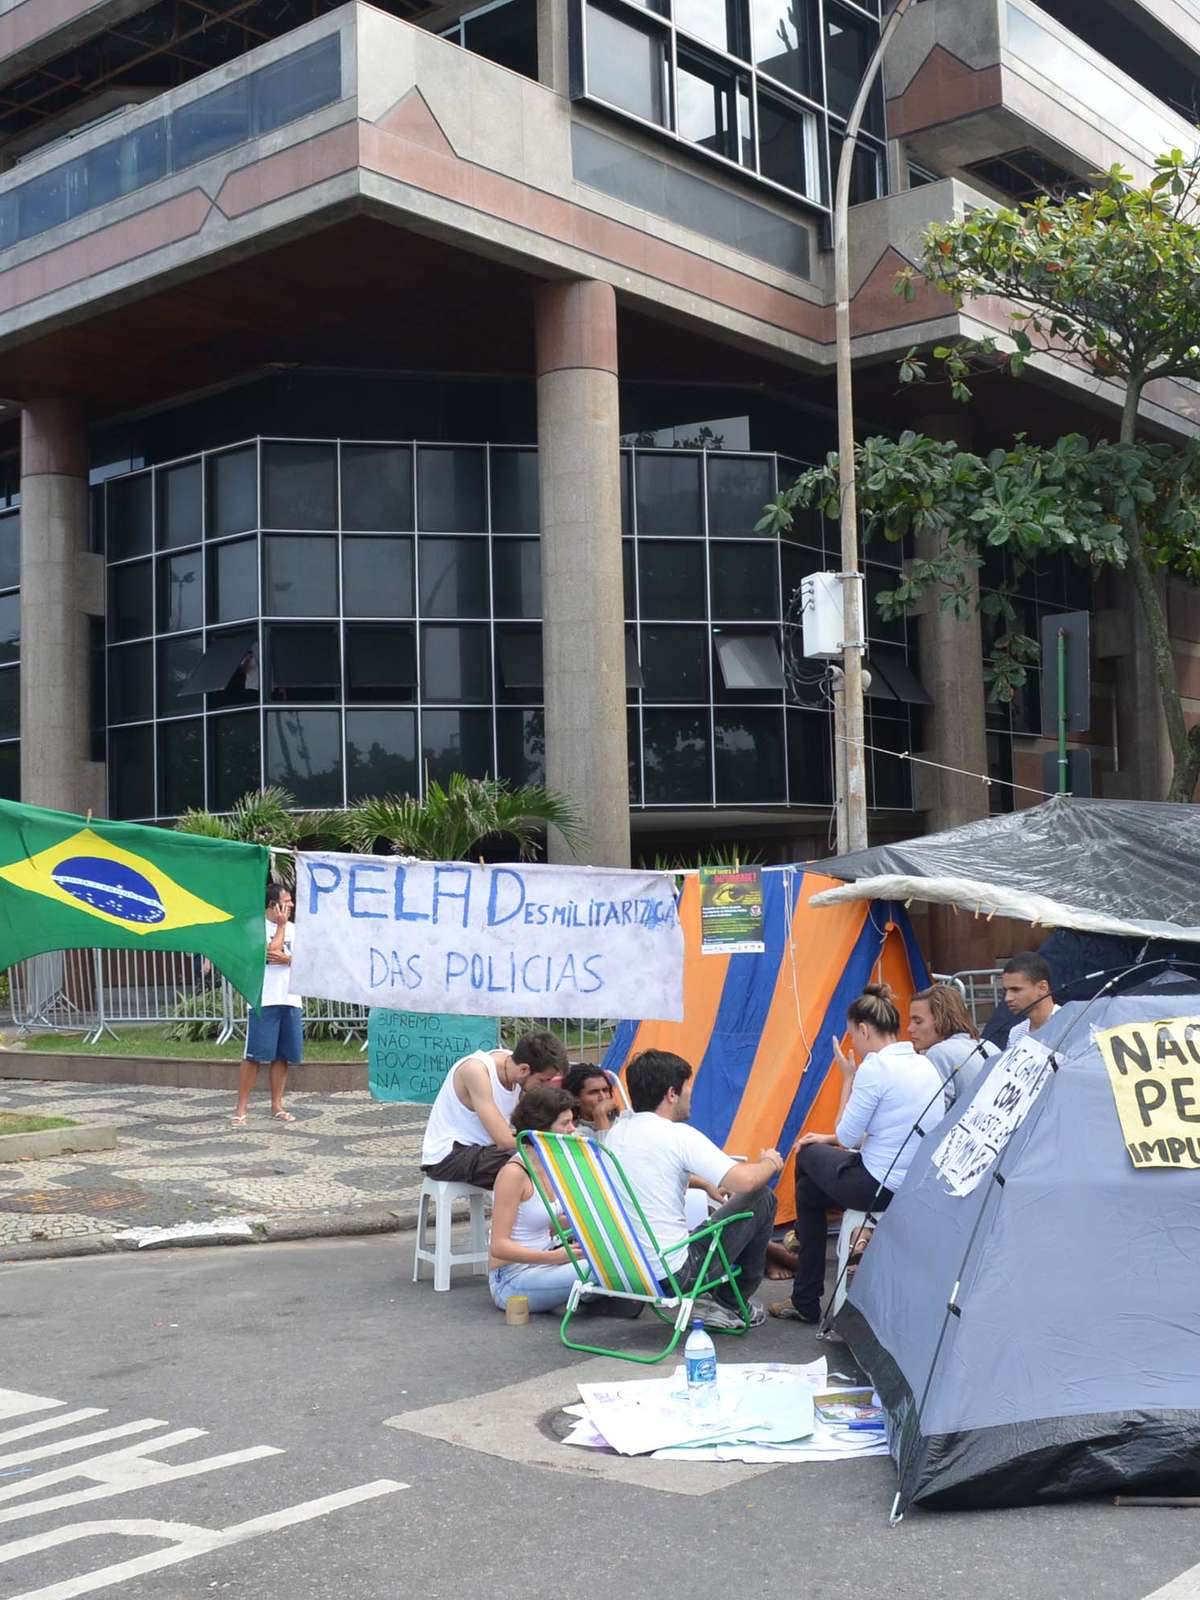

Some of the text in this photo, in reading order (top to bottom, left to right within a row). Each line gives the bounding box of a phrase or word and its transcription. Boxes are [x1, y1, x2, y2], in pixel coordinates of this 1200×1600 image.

[307, 862, 472, 928] PELA
[370, 947, 422, 990] DAS
[377, 1030, 411, 1050] NÃO
[376, 1051, 427, 1073] POVO!
[376, 1072, 401, 1091] NA
[993, 1081, 1023, 1117] COPA
